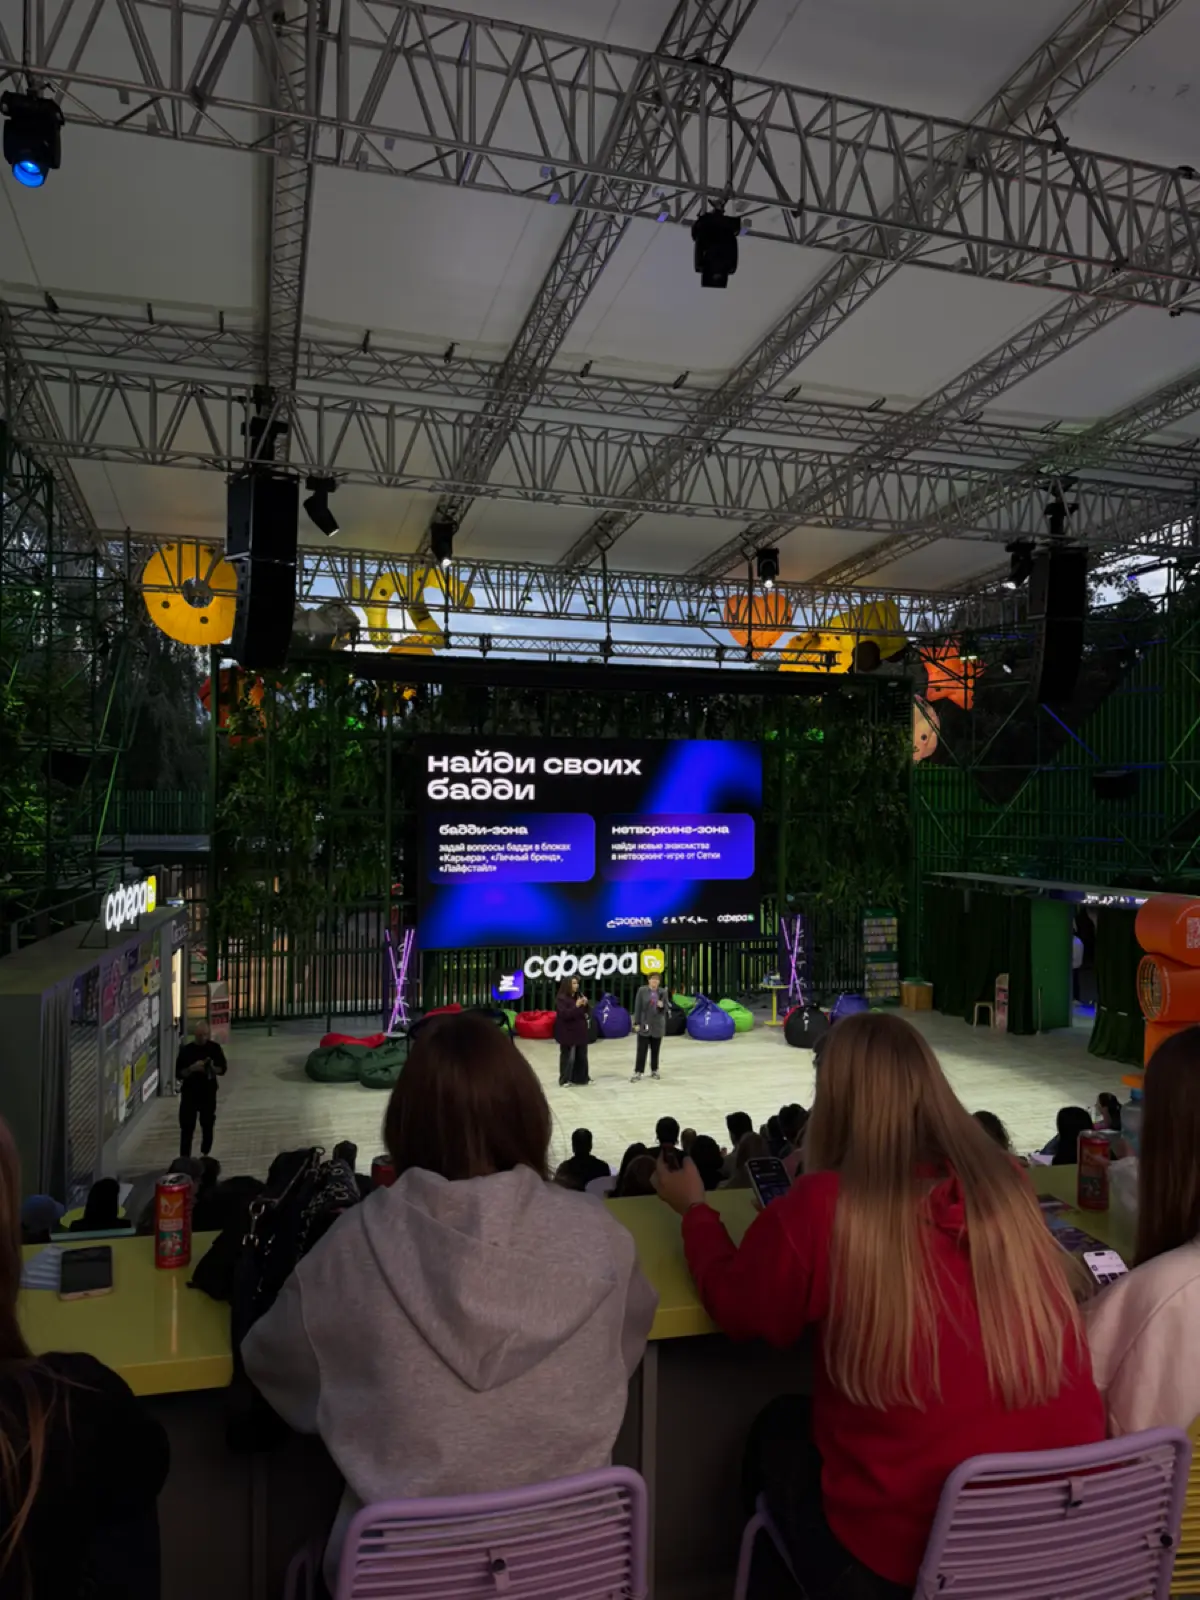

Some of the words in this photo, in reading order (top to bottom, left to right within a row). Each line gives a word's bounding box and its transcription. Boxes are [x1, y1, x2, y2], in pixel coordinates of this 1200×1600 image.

[427, 749, 535, 774] найди
[543, 758, 642, 776] своих
[427, 777, 535, 801] бадди
[439, 824, 529, 836] бадди-зона
[611, 825, 730, 836] нетворкинг-зона
[439, 843, 465, 853] задай
[466, 843, 505, 853] вопросы
[506, 842, 533, 853] бадди
[541, 841, 571, 851] блоках
[611, 841, 636, 851] найди
[664, 842, 710, 850] знакомства
[696, 851, 721, 860] Сетки
[105, 883, 148, 932] сфера
[523, 951, 637, 981] сфера
